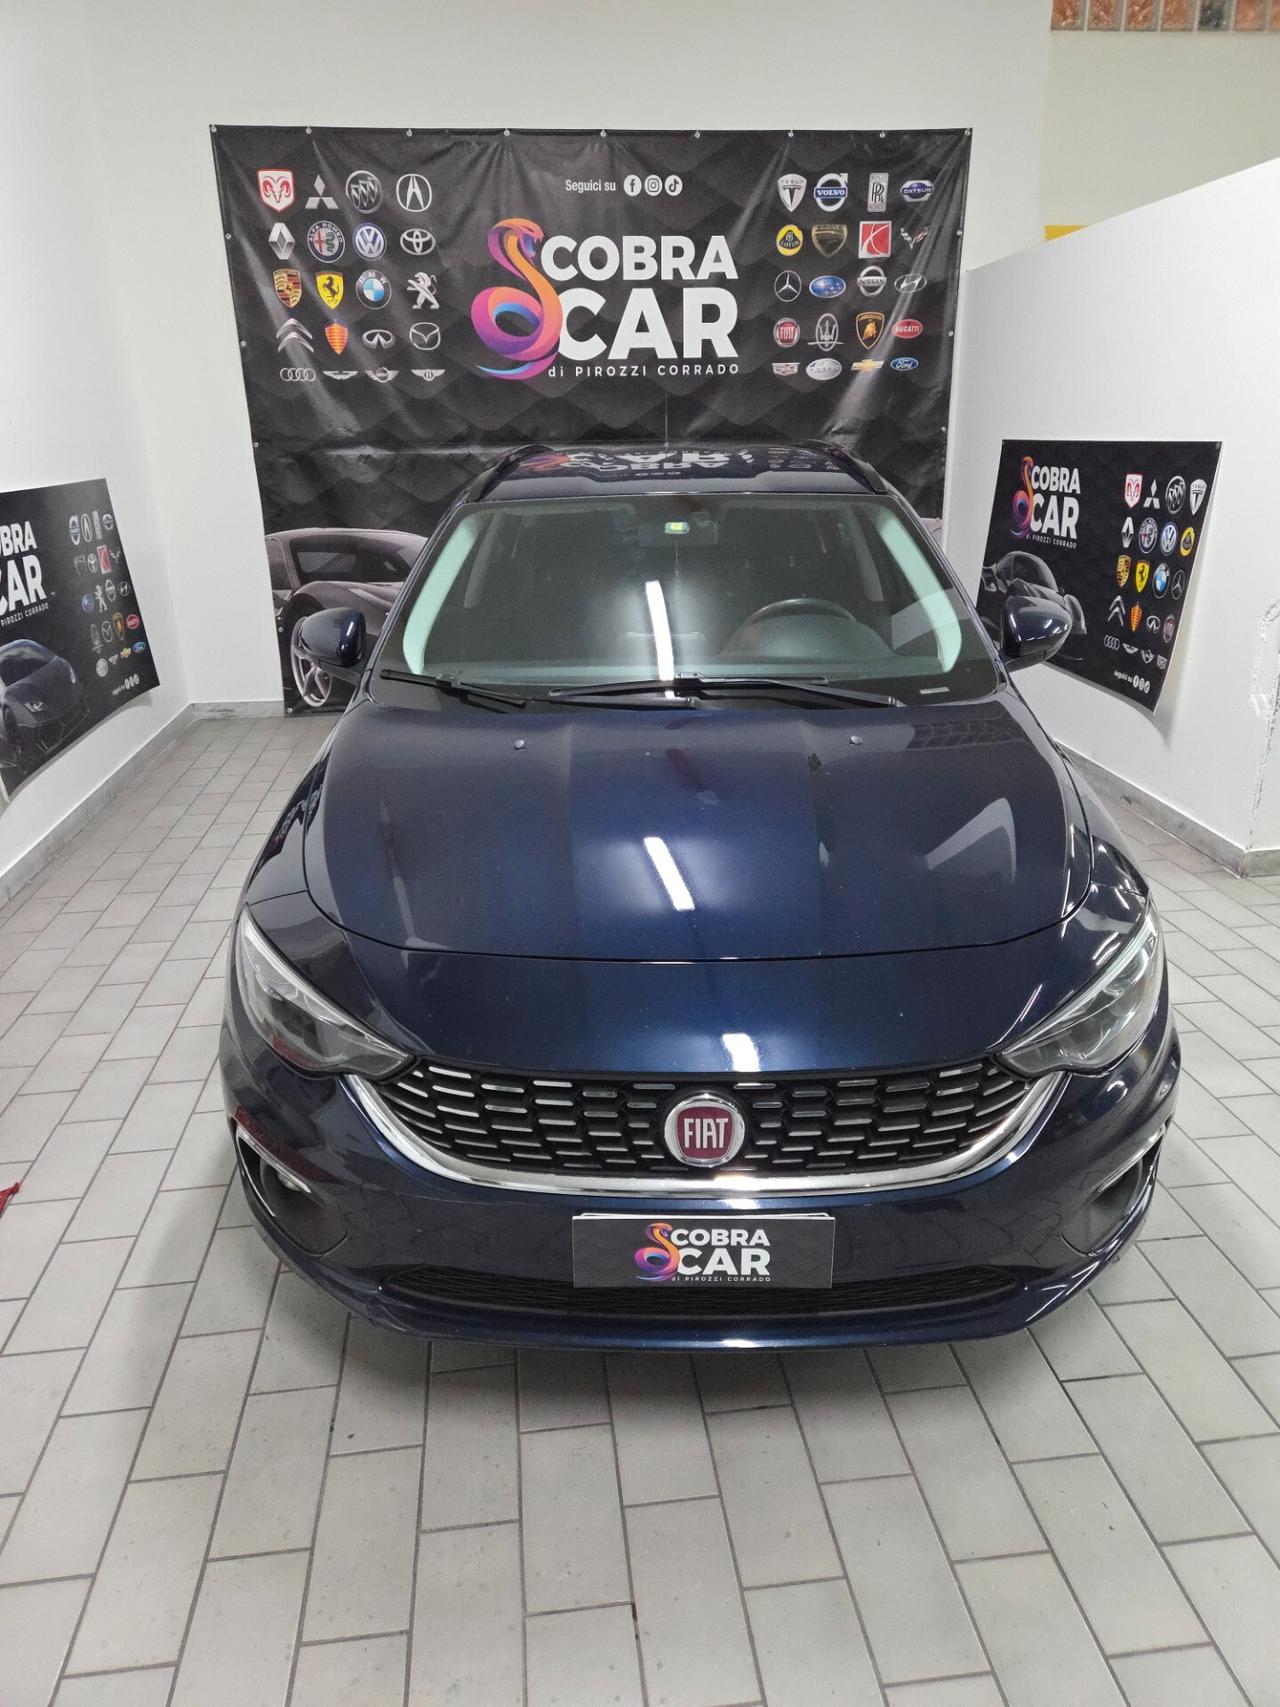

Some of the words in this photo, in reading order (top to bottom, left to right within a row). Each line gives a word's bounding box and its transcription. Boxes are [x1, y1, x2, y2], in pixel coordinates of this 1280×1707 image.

[565, 179, 602, 194] Seguici
[604, 181, 616, 191] su
[816, 189, 846, 197] VOLVO
[540, 235, 739, 281] COBRA
[358, 272, 388, 285] BMW
[557, 287, 739, 361] CAR
[548, 366, 564, 377] di
[575, 365, 646, 377] PIROZZI
[657, 363, 739, 376] CORRADO
[1031, 465, 1081, 494] COBRA
[1030, 493, 1078, 539] CAR
[0, 520, 38, 556] BRA
[684, 1117, 728, 1149] FIAT
[670, 1228, 770, 1246] COBRA
[677, 1247, 770, 1275] CAR
